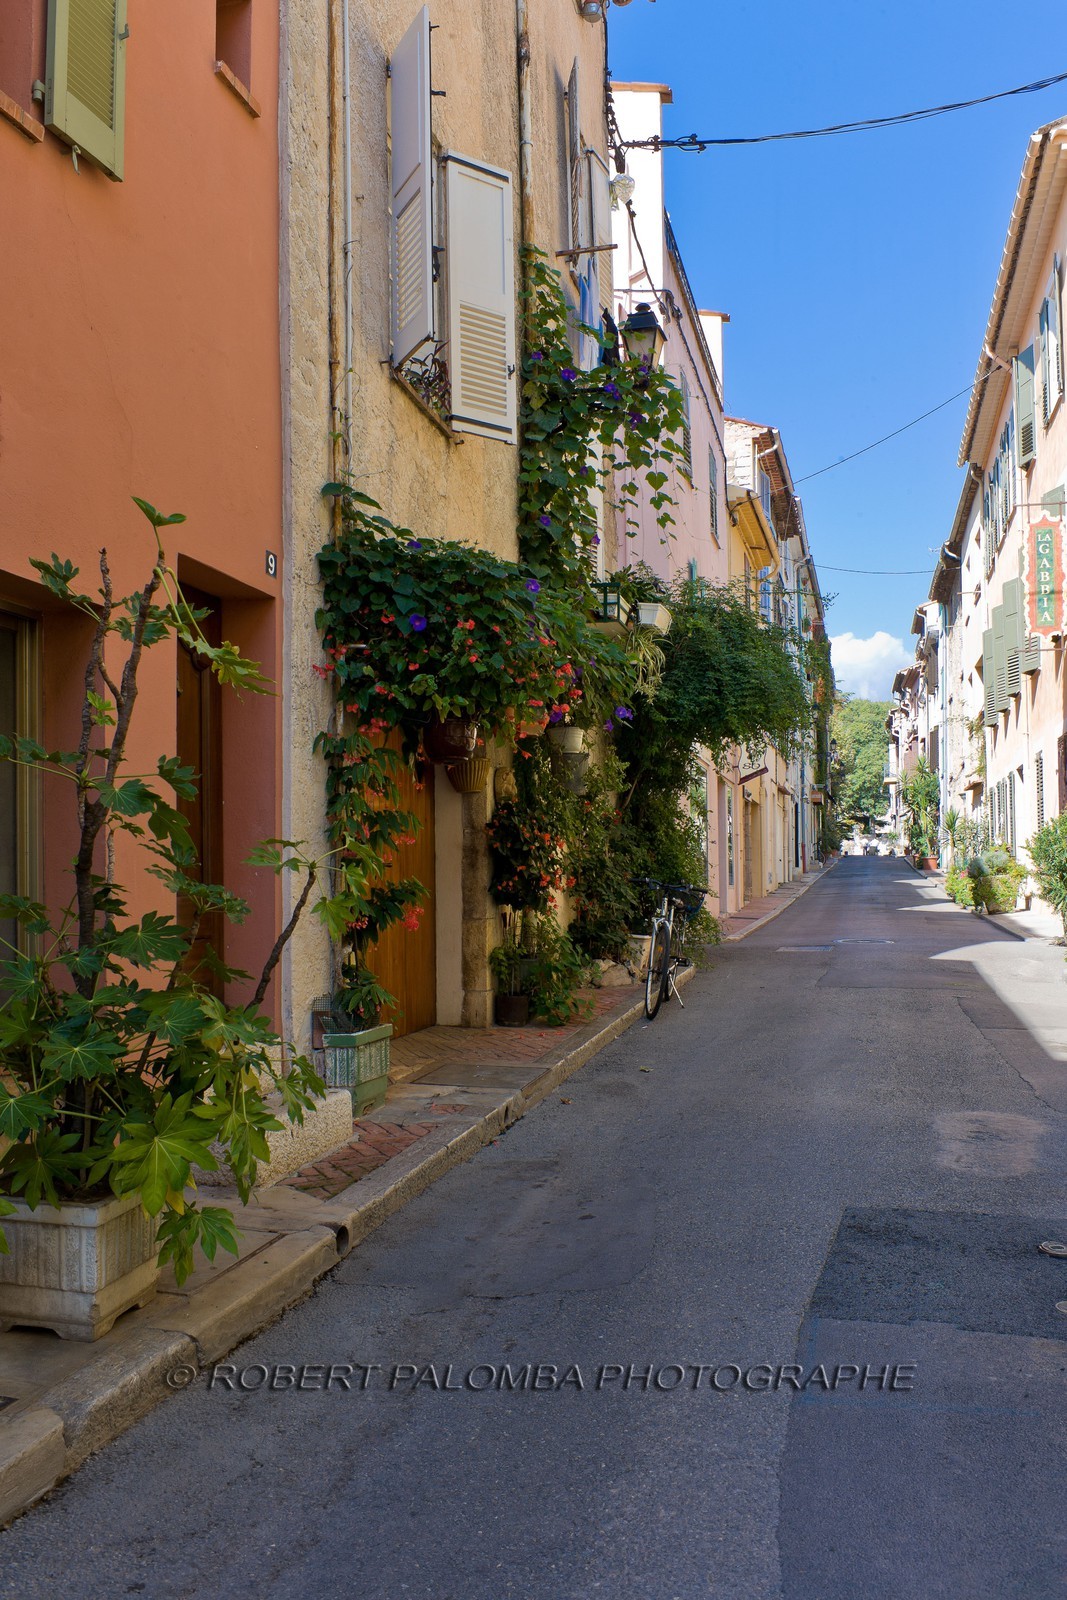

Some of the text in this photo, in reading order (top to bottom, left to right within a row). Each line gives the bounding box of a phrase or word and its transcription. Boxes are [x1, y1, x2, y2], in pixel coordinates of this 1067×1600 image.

[1037, 533, 1052, 542] LA
[268, 554, 275, 575] 9
[1038, 543, 1053, 621] GABBIA
